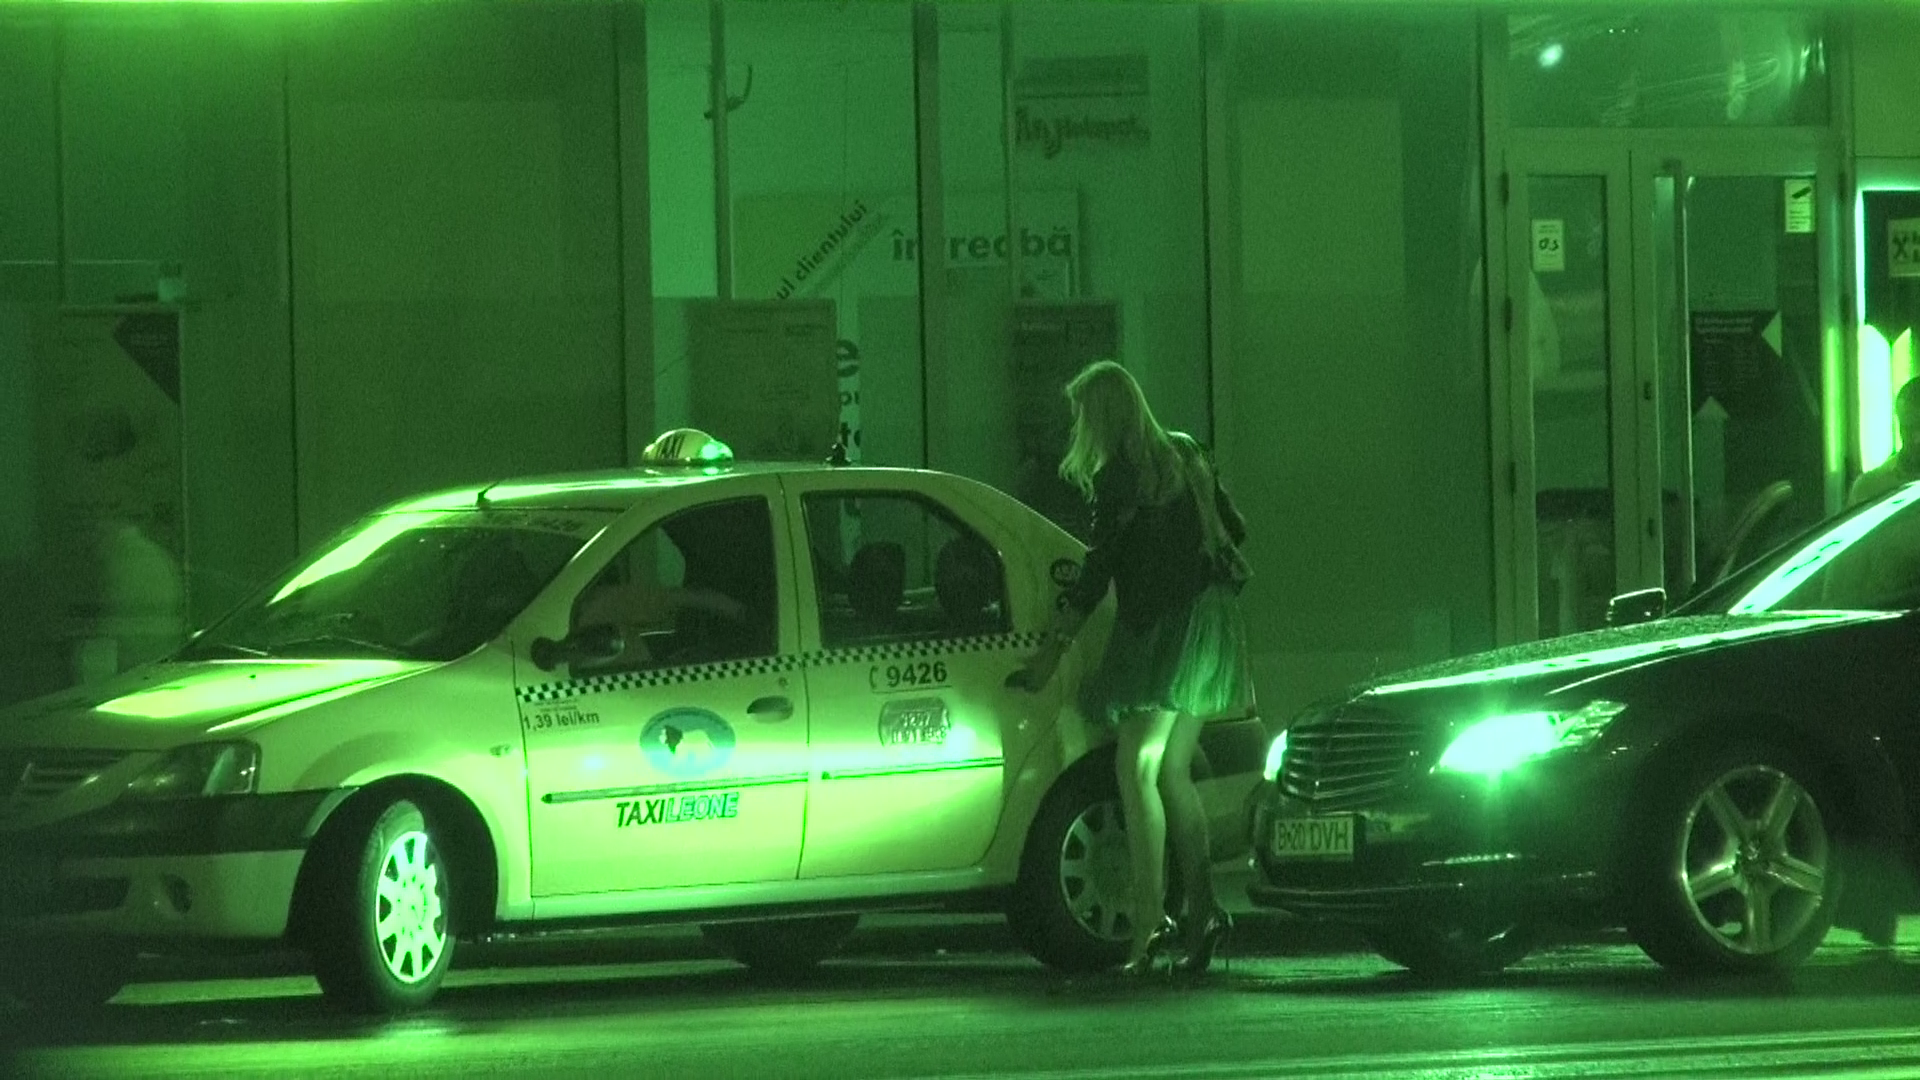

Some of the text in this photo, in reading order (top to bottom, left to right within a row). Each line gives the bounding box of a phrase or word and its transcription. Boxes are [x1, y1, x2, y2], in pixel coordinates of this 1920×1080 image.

[795, 199, 867, 281] clientului
[892, 226, 1072, 261] îreabă
[886, 661, 948, 687] 9426
[524, 711, 600, 731] 1,39 lei/km
[1310, 821, 1349, 850] DVH
